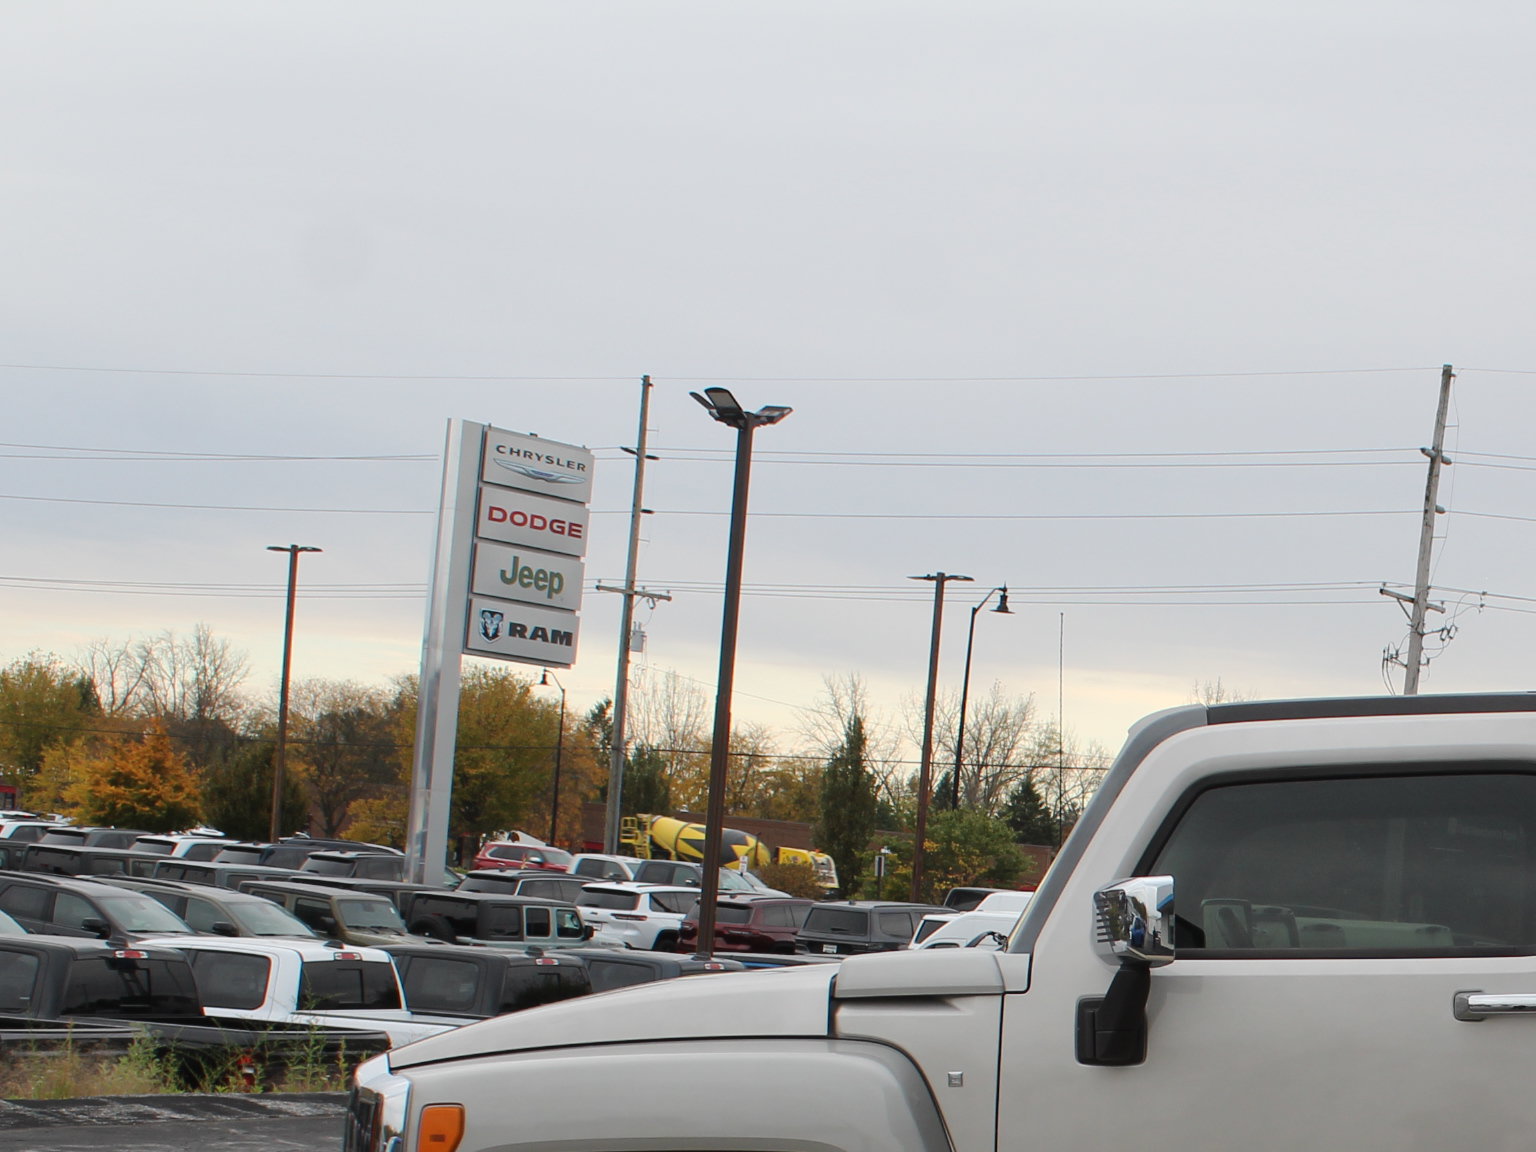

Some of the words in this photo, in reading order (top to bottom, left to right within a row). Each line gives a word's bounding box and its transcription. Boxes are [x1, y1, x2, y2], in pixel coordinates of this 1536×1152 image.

[495, 445, 586, 472] CHRYSLER
[488, 505, 583, 539] DODGE
[500, 555, 564, 599] Jeep
[508, 621, 574, 647] RAM
